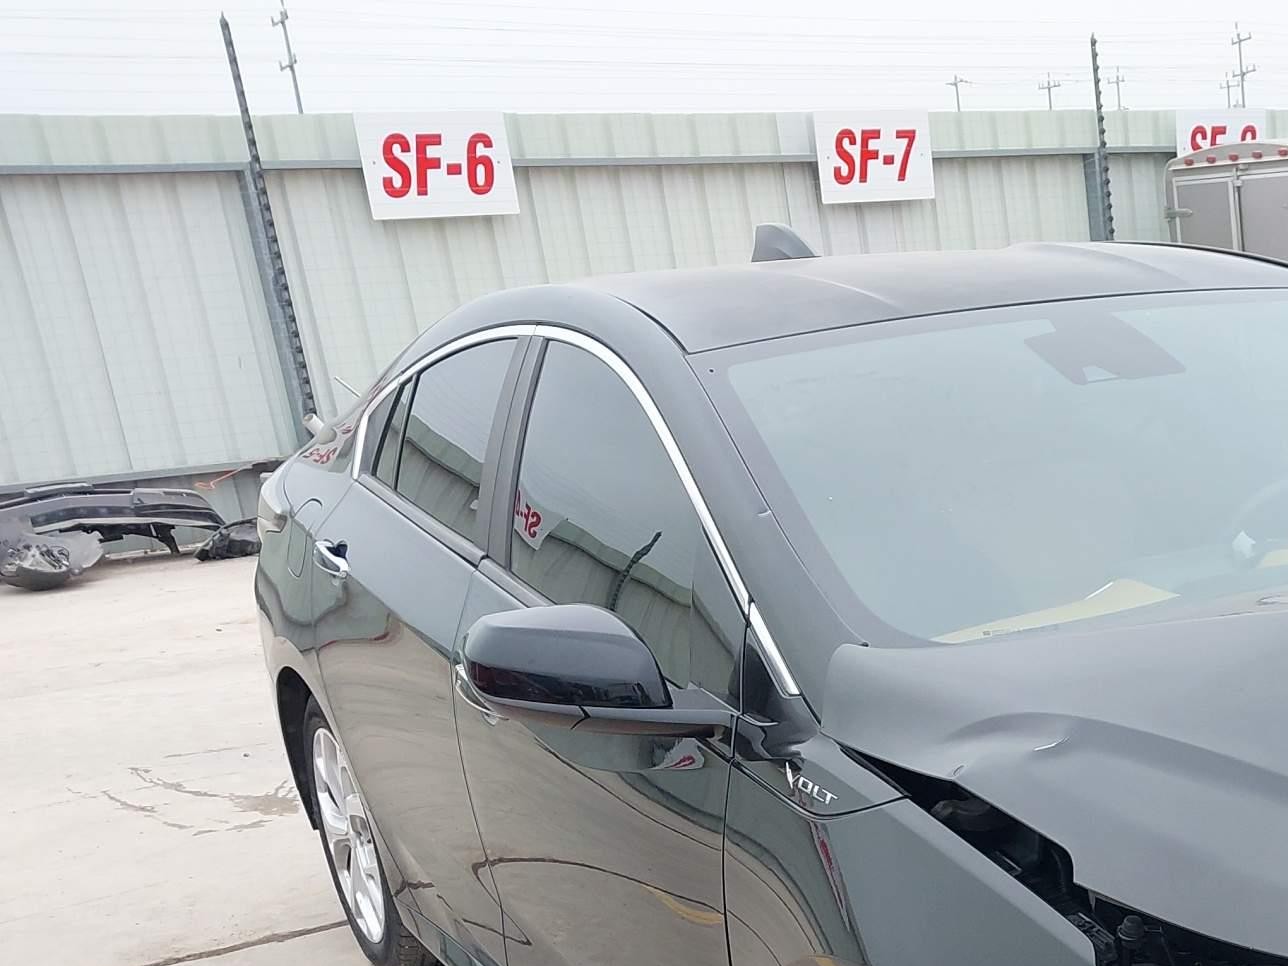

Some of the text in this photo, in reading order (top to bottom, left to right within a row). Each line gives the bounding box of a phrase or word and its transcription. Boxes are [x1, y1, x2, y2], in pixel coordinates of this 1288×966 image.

[380, 131, 496, 199] SF-6
[832, 127, 918, 186] SF-7
[785, 761, 839, 805] VOLT
